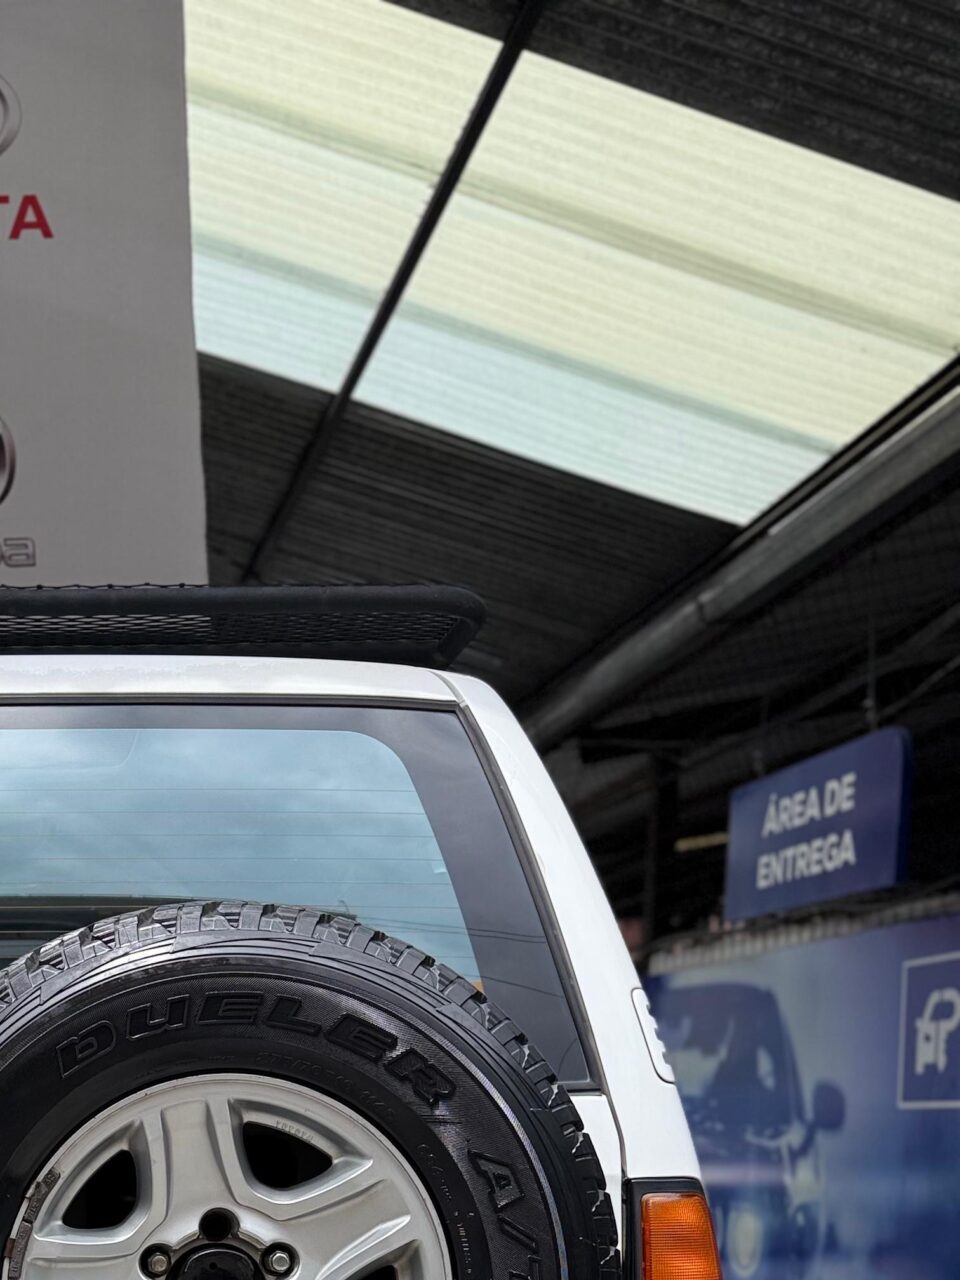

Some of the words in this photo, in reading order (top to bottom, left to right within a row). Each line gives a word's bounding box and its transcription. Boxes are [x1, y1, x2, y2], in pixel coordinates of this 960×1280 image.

[761, 787, 821, 839] ÁREA
[824, 772, 857, 818] DE
[755, 829, 857, 891] ENTREGA
[56, 991, 456, 1107] DUELER
